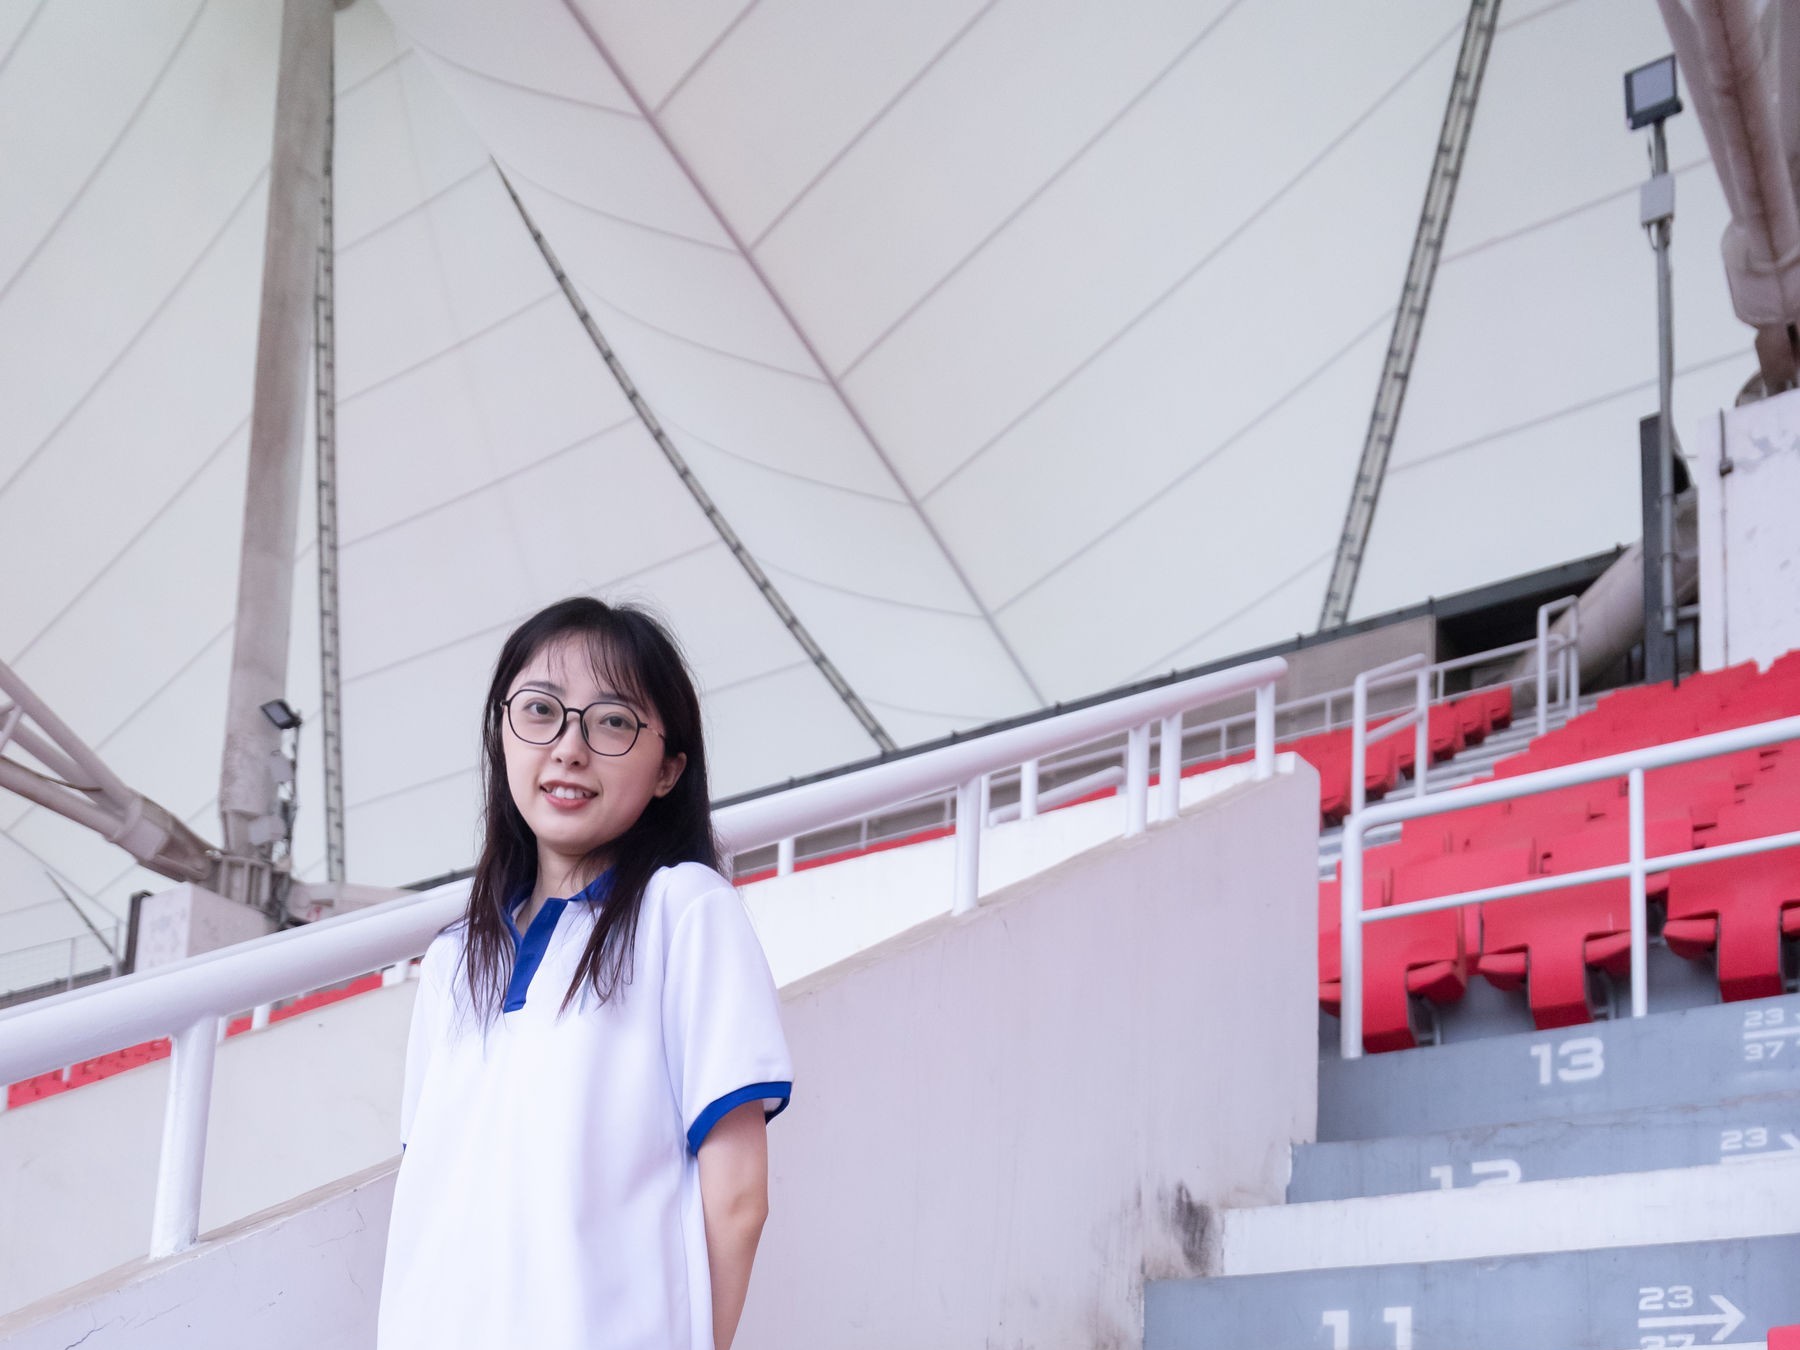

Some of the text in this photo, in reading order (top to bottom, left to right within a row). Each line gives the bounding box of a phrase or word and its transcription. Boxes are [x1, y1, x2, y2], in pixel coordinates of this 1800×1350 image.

[1743, 1007, 1785, 1029] 23
[1530, 1037, 1604, 1085] 13
[1743, 1040, 1786, 1061] 37
[1720, 1127, 1768, 1151] 23
[1638, 1285, 1694, 1311] 23
